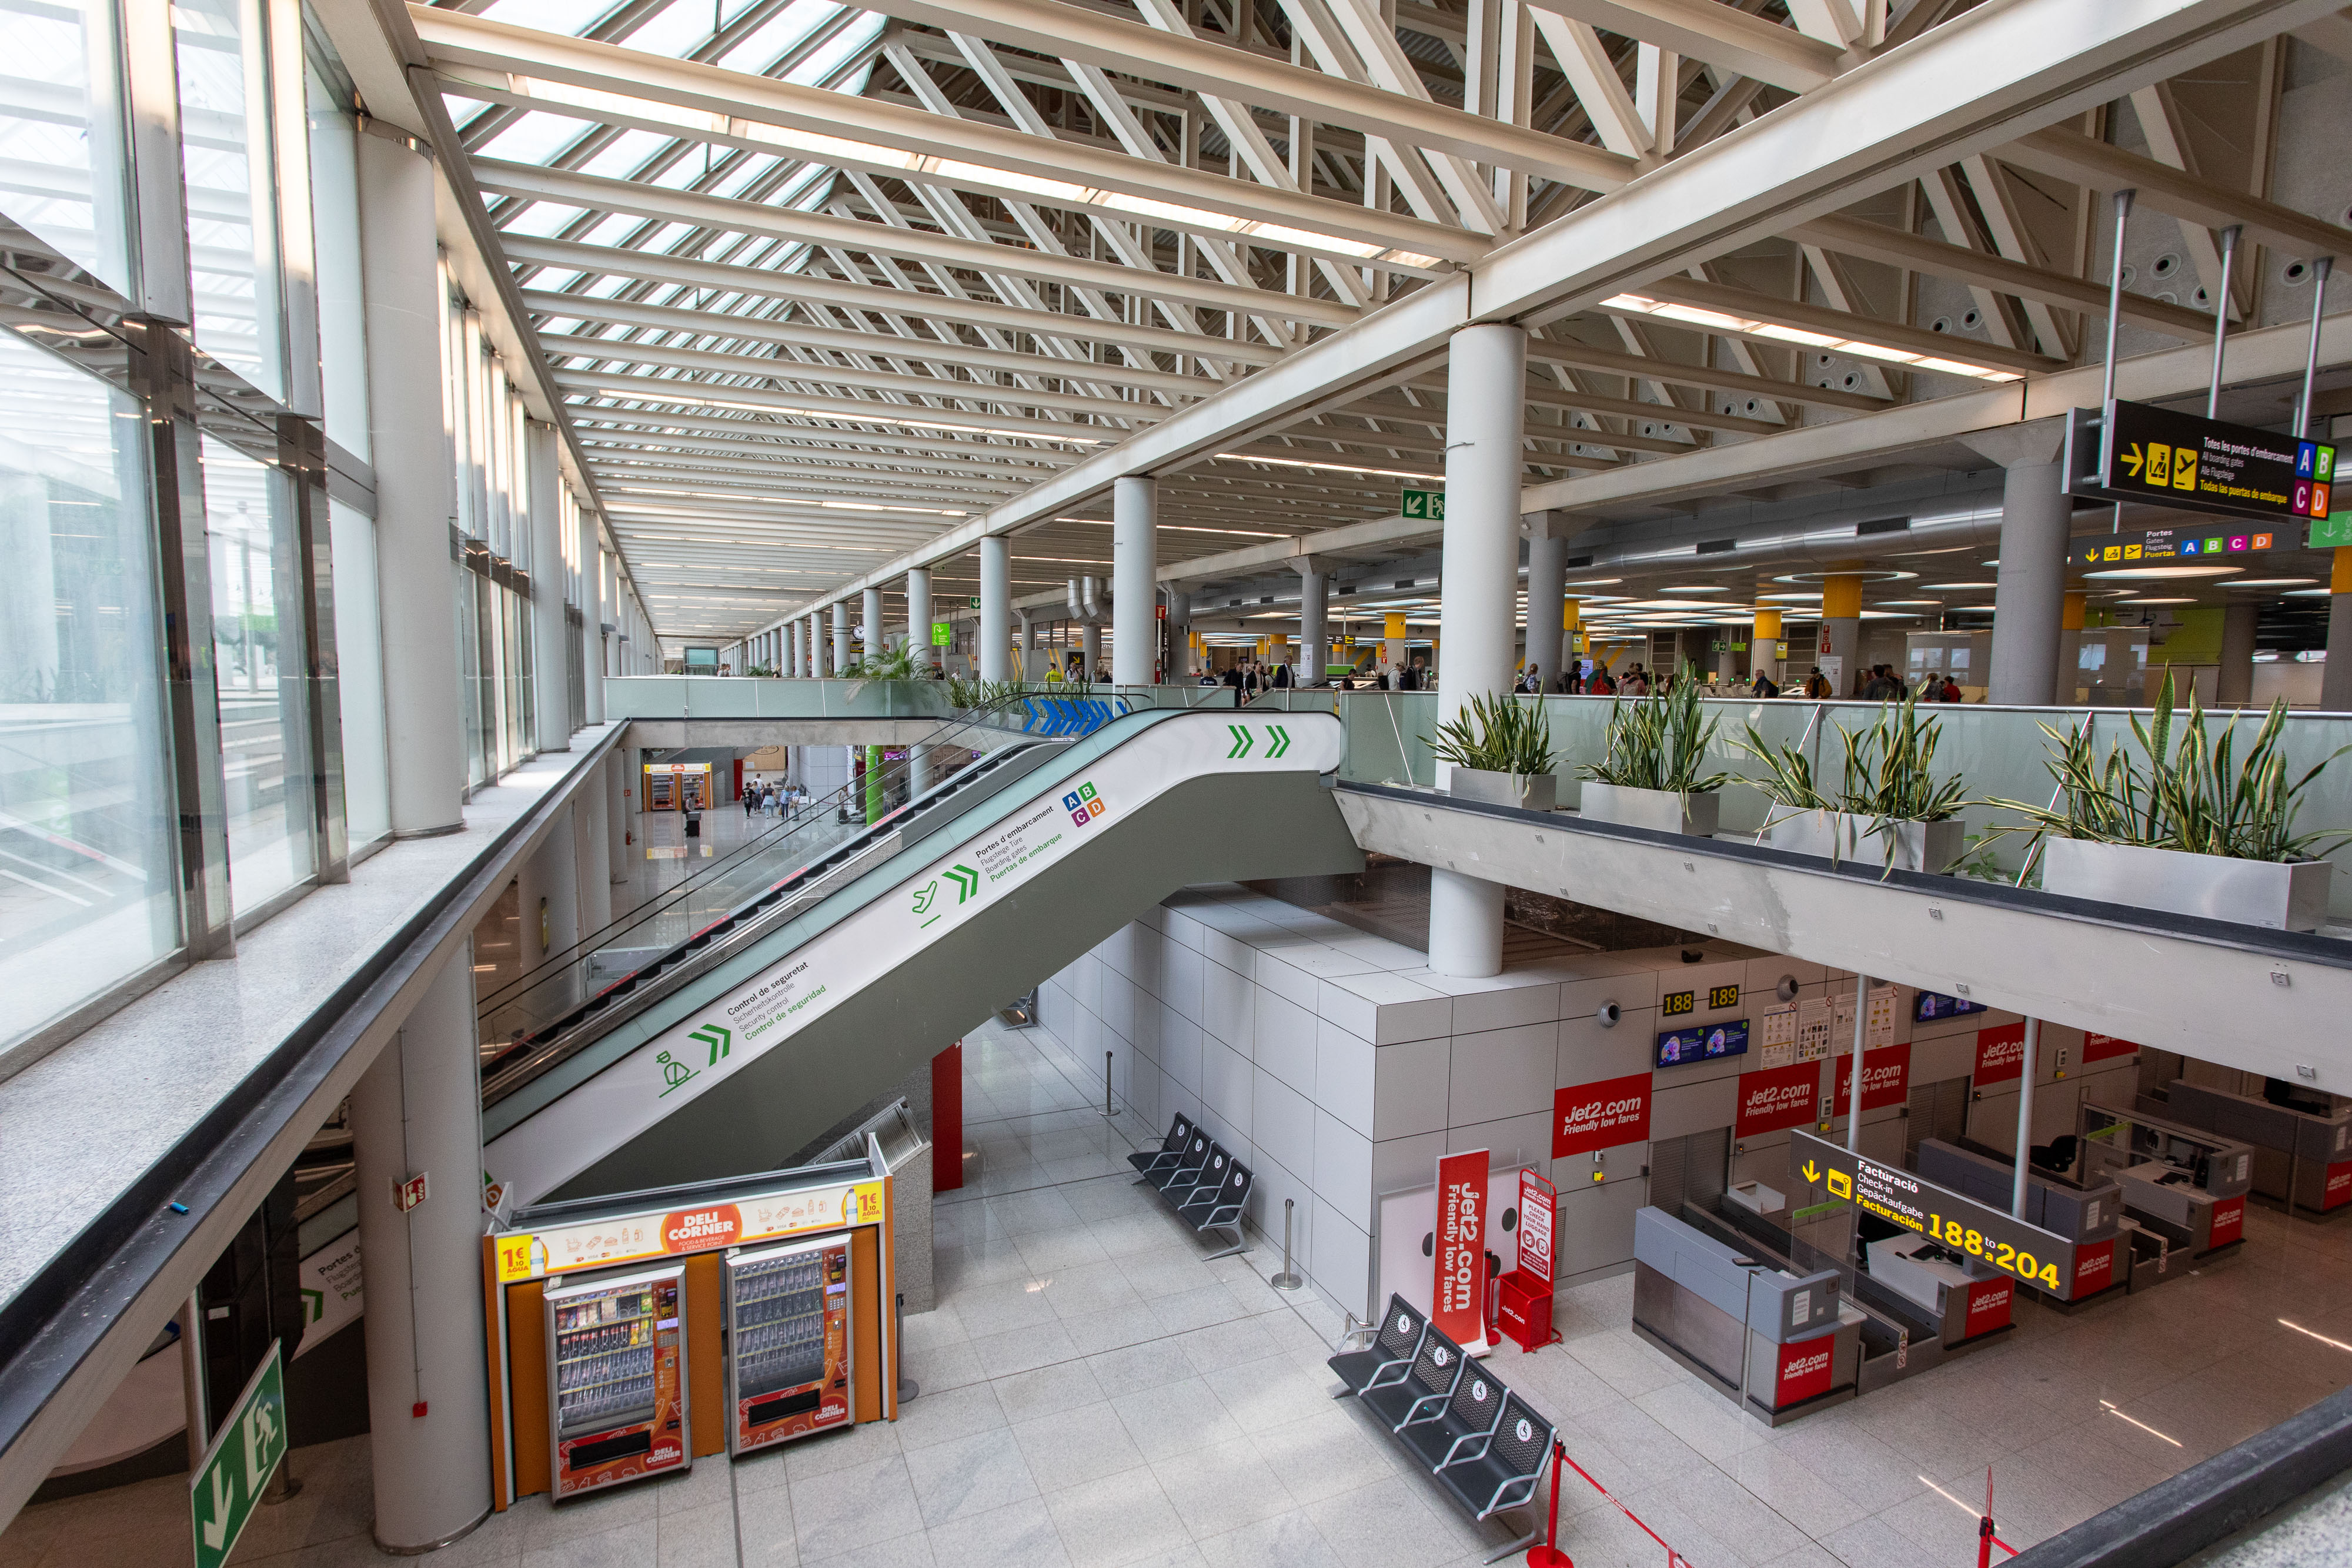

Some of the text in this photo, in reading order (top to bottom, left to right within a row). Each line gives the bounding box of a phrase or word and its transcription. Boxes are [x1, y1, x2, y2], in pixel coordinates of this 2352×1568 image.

[2204, 437, 2294, 464] Totes les portes d'embarcament
[2209, 453, 2230, 467] boarding
[2230, 459, 2244, 467] gates
[2300, 449, 2328, 474] A B
[2201, 466, 2234, 481] Alle Flugsteige
[2200, 480, 2287, 504] Todas las puertas de embarque
[2296, 487, 2323, 510] C D
[2185, 537, 2266, 552] A B C D
[1084, 786, 1092, 796] B
[1068, 796, 1078, 807] A
[1093, 803, 1101, 814] D
[1076, 811, 1086, 823] C
[975, 841, 1000, 858] Portes
[980, 837, 1023, 866] Flugsteige Türe
[985, 844, 1027, 874] Boarding gates
[990, 834, 1063, 882] Puertas de embarque
[727, 961, 808, 1015] Control de seguretat
[733, 982, 795, 1024] Sicherheitskontrolle
[1665, 988, 1737, 1014] 188 189
[739, 997, 789, 1032] Security control
[745, 985, 827, 1040] Control de seguridad
[1983, 1041, 2024, 1058] Jet2.co
[1982, 1057, 2005, 1068] Friendly
[1843, 1065, 1901, 1086] J2.com
[1746, 1083, 1810, 1106] Jet2.com
[1842, 1079, 1900, 1096] Frily low fares
[1565, 1097, 1641, 1124] Jet2.com
[1745, 1098, 1809, 1117] Friendly low fares
[1563, 1113, 1639, 1136] Friendly low fares
[1857, 1172, 1893, 1195] Check-in
[488, 1190, 499, 1203] D
[1524, 1186, 1551, 1205] Jet2.com
[1524, 1191, 1536, 1201] Friendly
[1857, 1183, 1924, 1219] Gepäckaufgabe
[684, 1211, 718, 1228] DELI
[1529, 1205, 1546, 1218] PLEASE
[1529, 1211, 1545, 1223] CHECK
[669, 1221, 734, 1241] CORNER
[1524, 1213, 1550, 1232] YOUR HAND
[1525, 1222, 1547, 1237] LUGGAGE
[1856, 1193, 1983, 1256] Facturación 188
[700, 1235, 725, 1243] BEVERAGE
[1456, 1182, 1479, 1310] Jet2.com
[1984, 1236, 1996, 1249] to
[1443, 1185, 1460, 1313] Friendly low fares
[1984, 1251, 1994, 1263] a
[319, 1253, 353, 1275] Portes
[1996, 1242, 2060, 1290] 204
[2079, 1254, 2110, 1271] Jet2.com
[1972, 1290, 2009, 1308] Jet2.com
[1785, 1352, 1828, 1373] Jet2.com
[1783, 1369, 1804, 1380] Friendly
[815, 1408, 846, 1420] CORNER
[822, 1404, 838, 1413] DELI
[646, 1450, 681, 1463] CORNER
[654, 1446, 673, 1456] DELI
